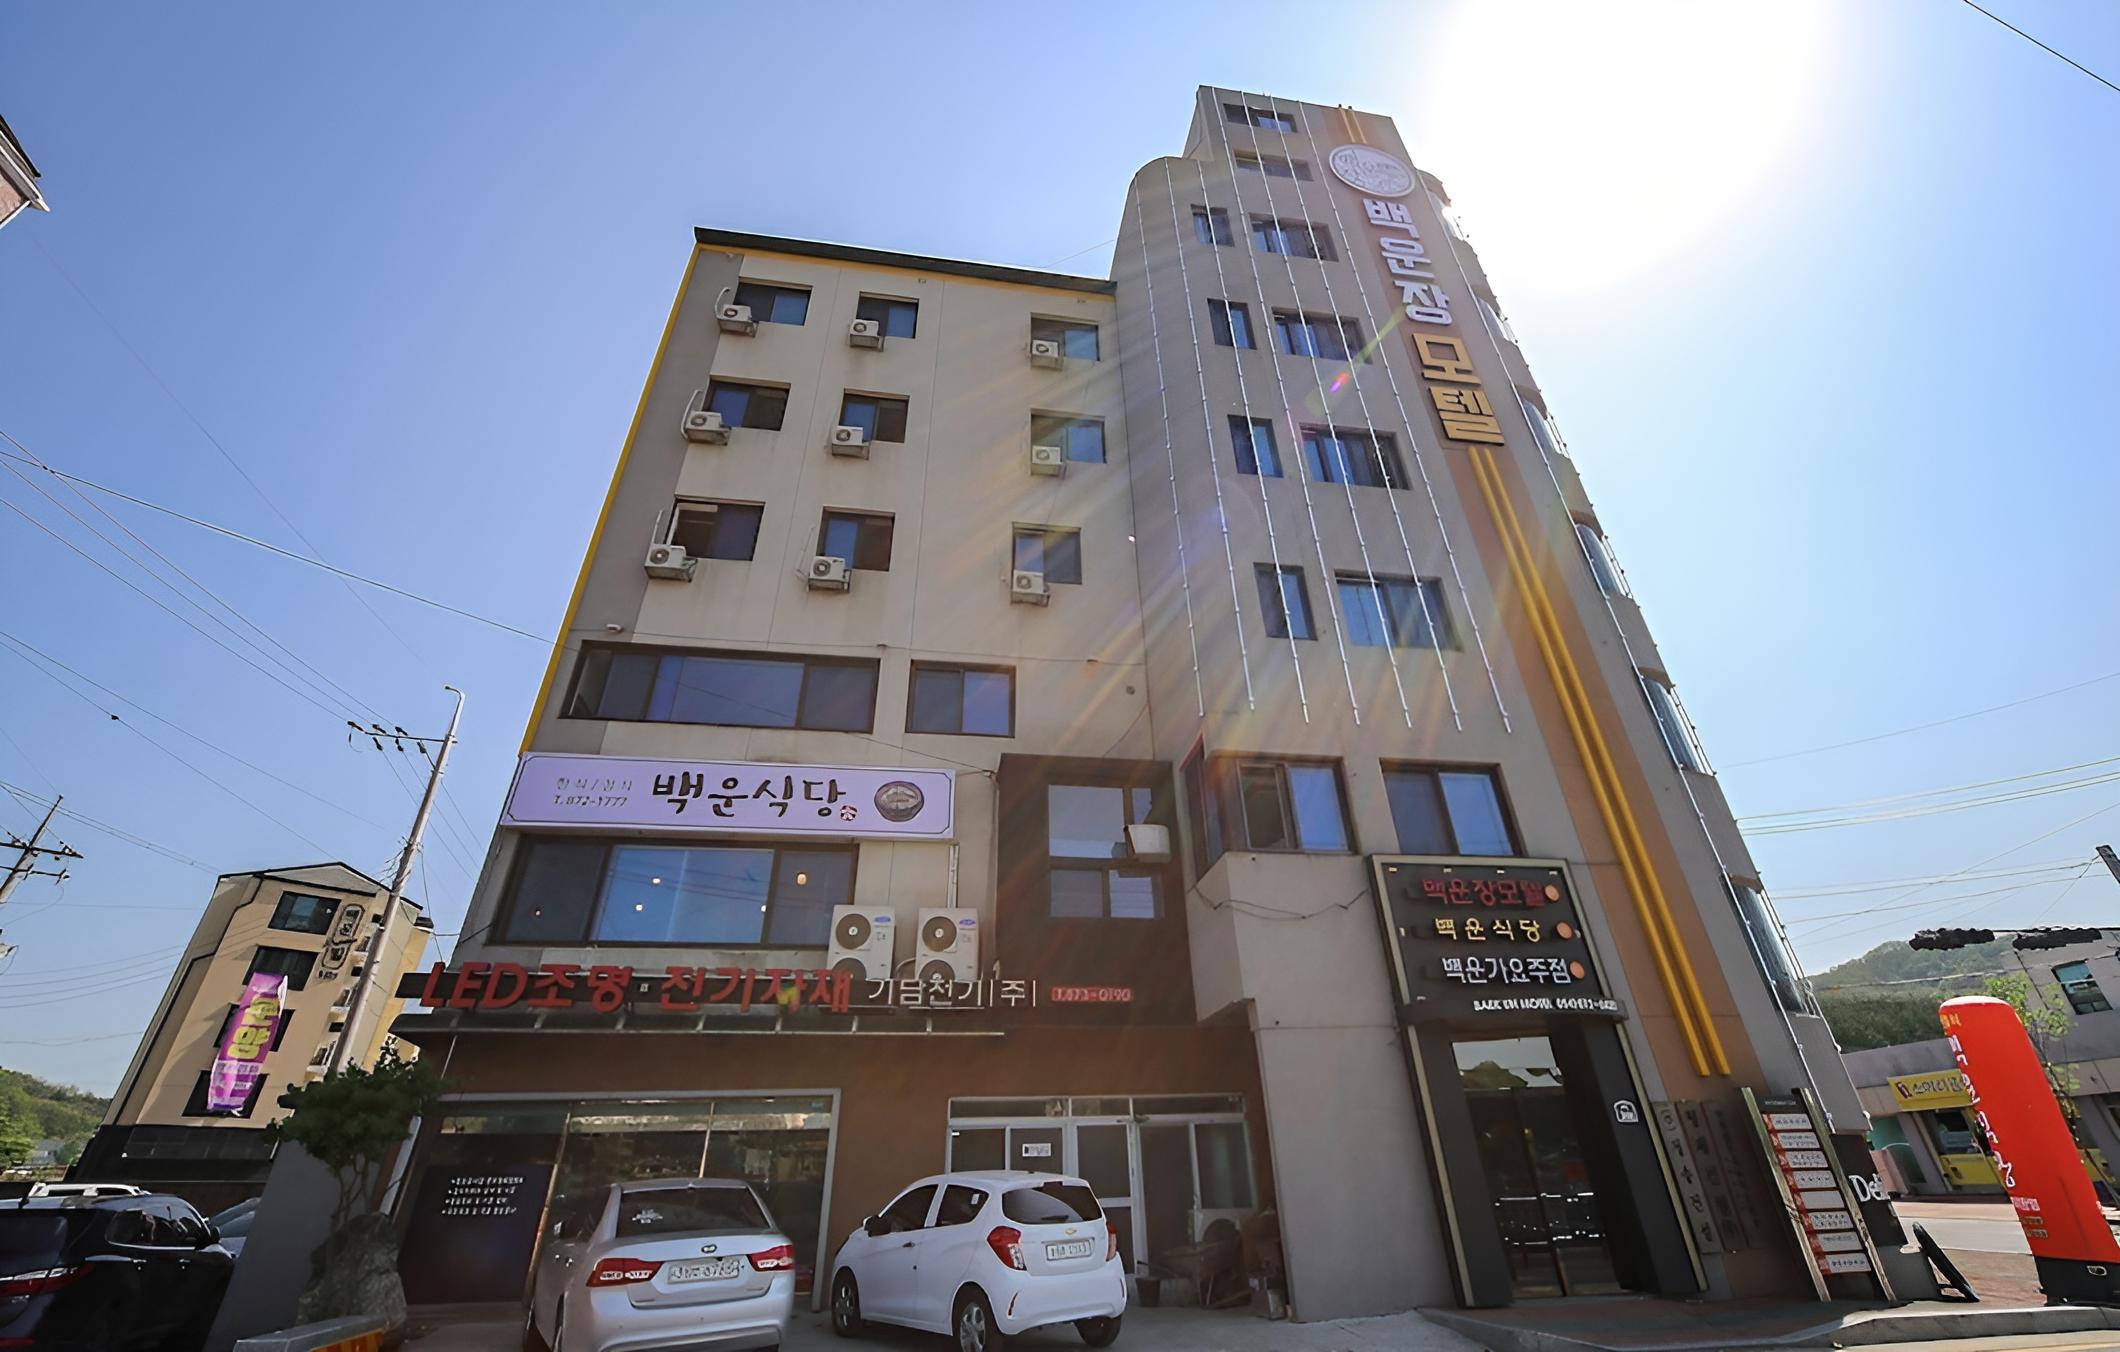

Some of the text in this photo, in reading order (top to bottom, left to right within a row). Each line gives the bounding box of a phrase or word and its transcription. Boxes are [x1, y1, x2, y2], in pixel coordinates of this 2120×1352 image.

[1363, 198, 1453, 325] 백운장
[1413, 332, 1505, 446] 모텔
[652, 771, 847, 817] 백운식당
